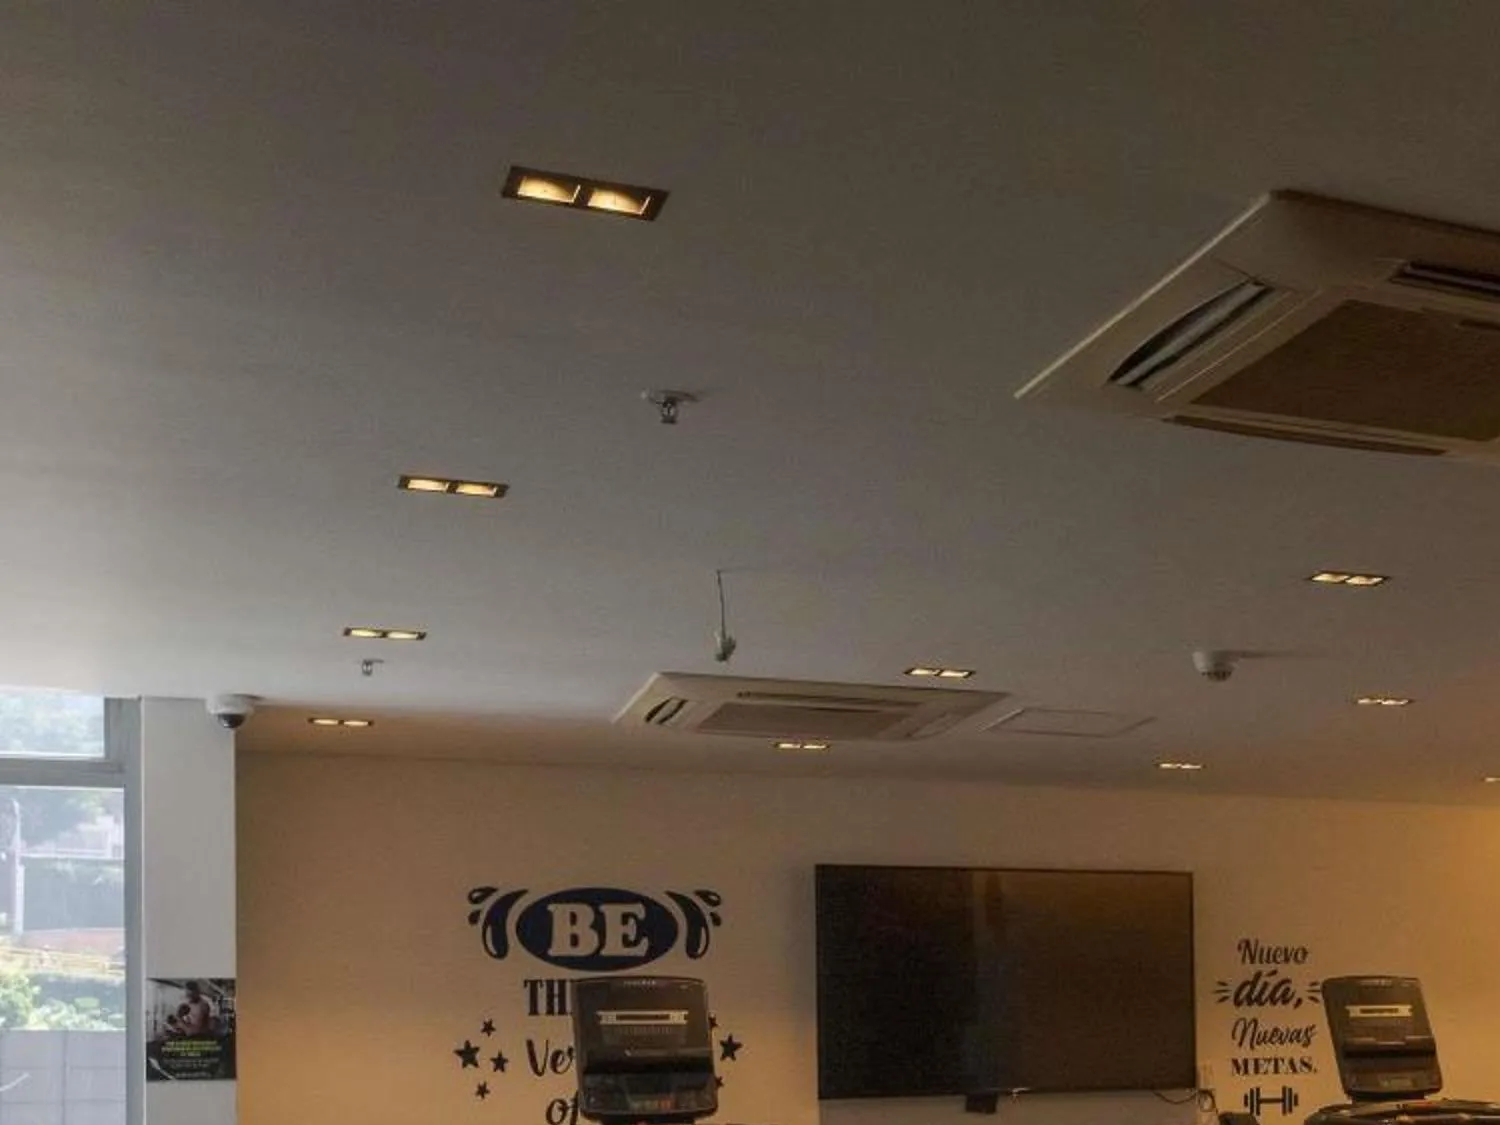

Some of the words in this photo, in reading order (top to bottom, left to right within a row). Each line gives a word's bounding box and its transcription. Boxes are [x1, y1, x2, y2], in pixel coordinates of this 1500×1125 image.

[547, 902, 649, 957] BE
[1238, 938, 1308, 965] Nuevo
[524, 979, 573, 1016] TH
[1232, 1017, 1316, 1050] Nuevas
[1231, 1057, 1317, 1075] METAS.
